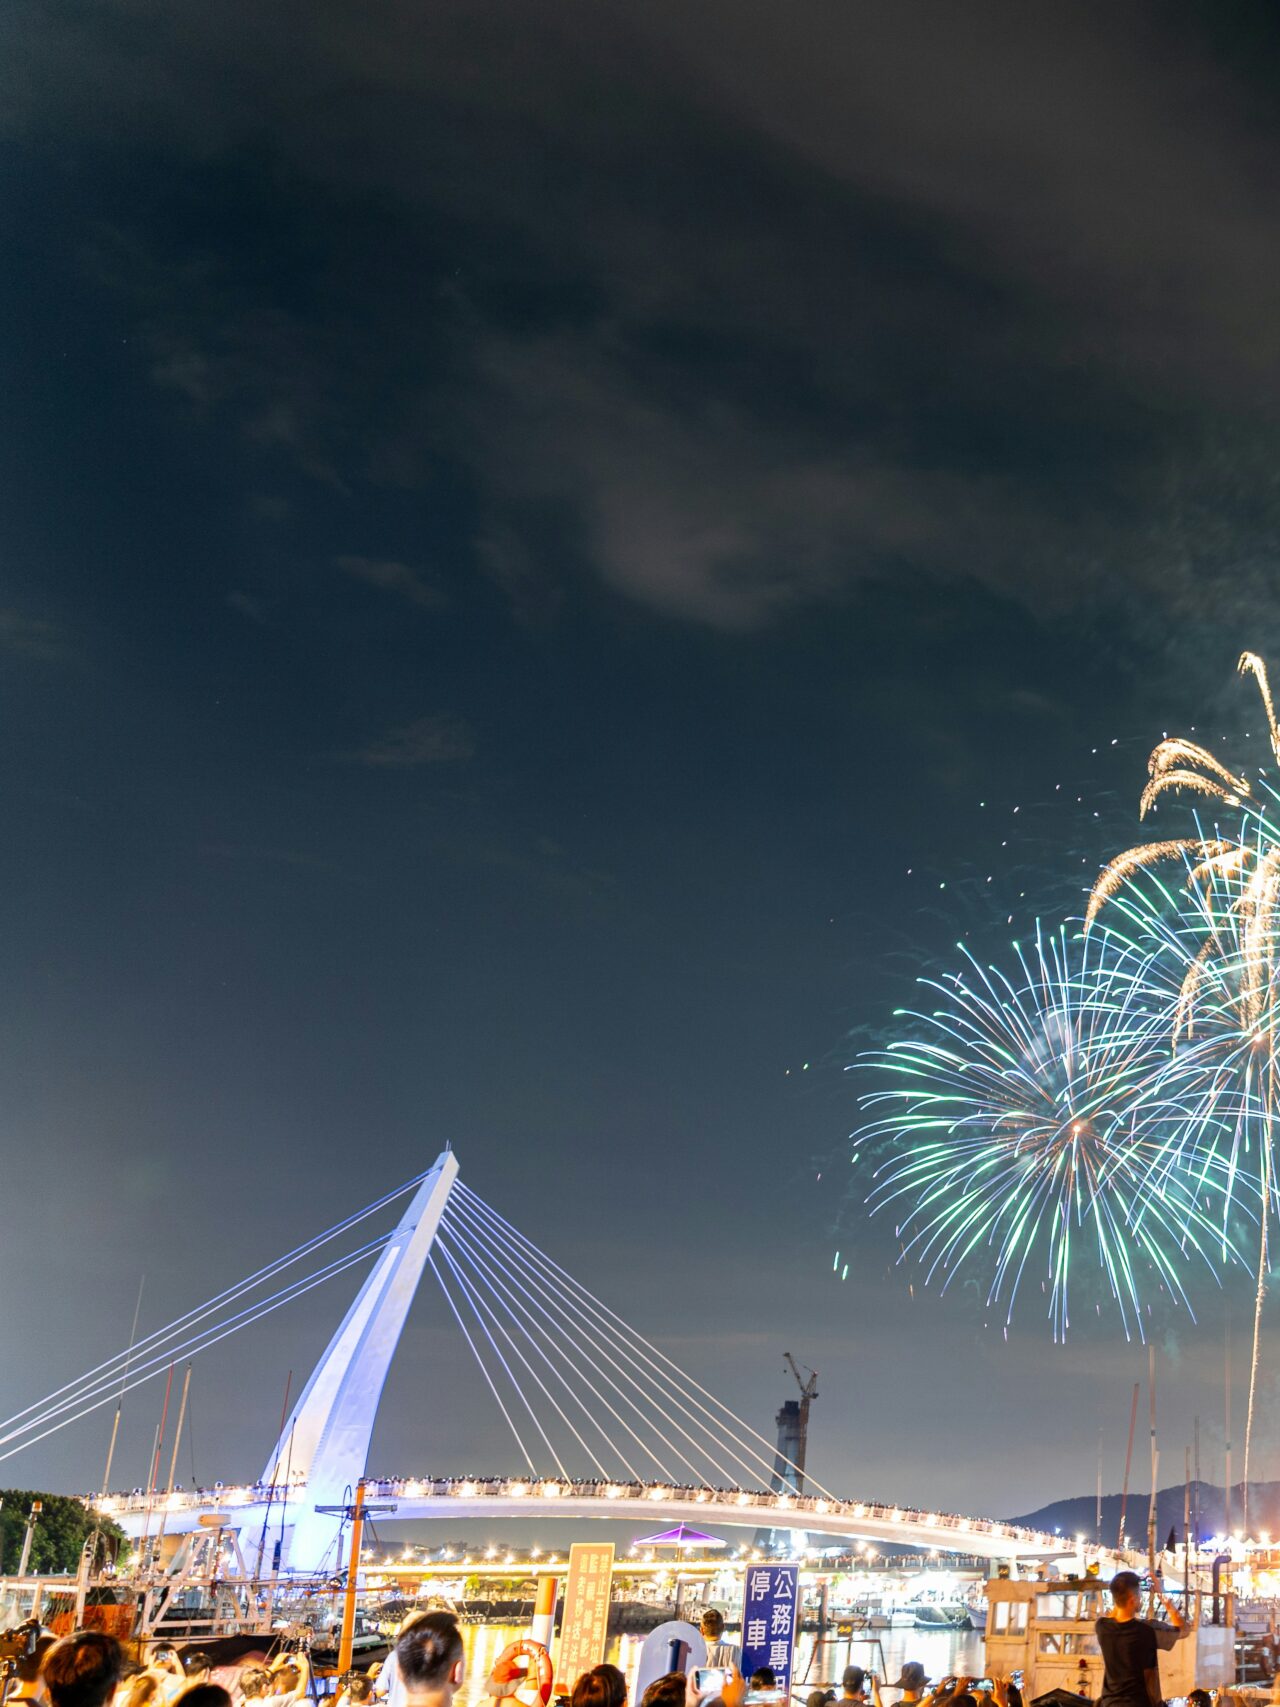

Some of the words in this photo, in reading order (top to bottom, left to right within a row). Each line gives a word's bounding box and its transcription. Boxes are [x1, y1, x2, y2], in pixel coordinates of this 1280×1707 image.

[589, 1553, 610, 1673] 禁止丟棄垃
[745, 1570, 771, 1688] 停車
